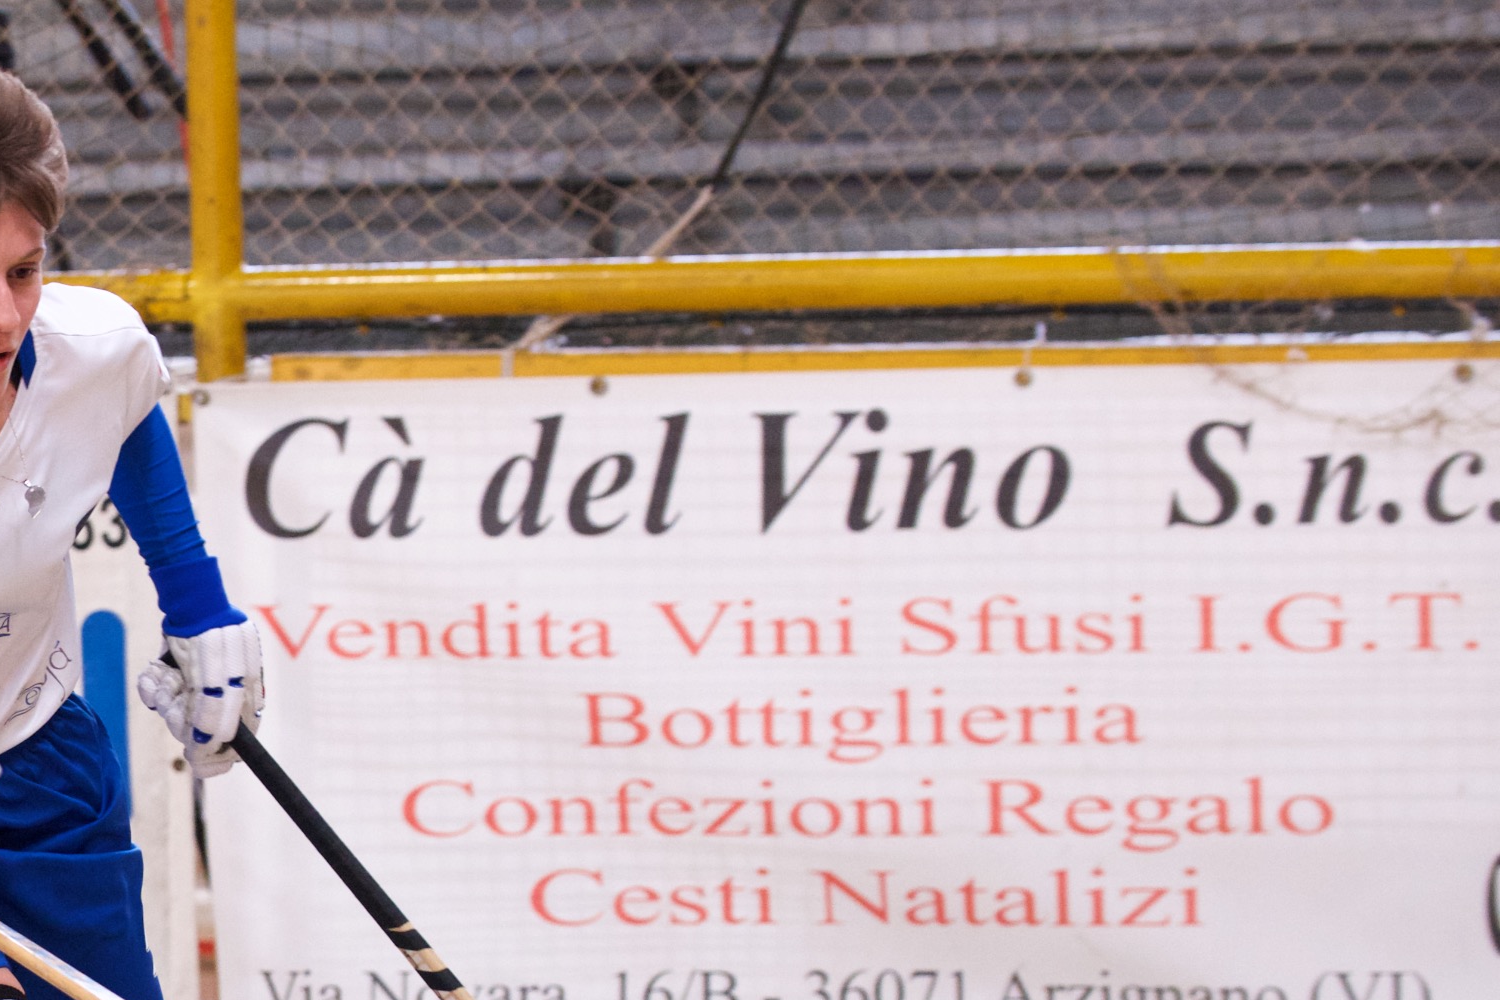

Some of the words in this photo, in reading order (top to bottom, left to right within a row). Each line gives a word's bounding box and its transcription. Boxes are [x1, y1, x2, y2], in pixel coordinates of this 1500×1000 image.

[244, 415, 424, 540] Cà
[479, 412, 689, 538] del
[751, 408, 1072, 534] Vino
[250, 602, 616, 660] Vendita
[653, 598, 856, 657] Vini
[900, 595, 1146, 656] Sfusi
[1192, 592, 1480, 652] I.G.T.
[580, 687, 1144, 764] Bottiglieria
[401, 778, 940, 838] Confezioni
[983, 777, 1336, 853] Regalo
[528, 868, 774, 927] Cesti
[811, 868, 1205, 928] Natalizi
